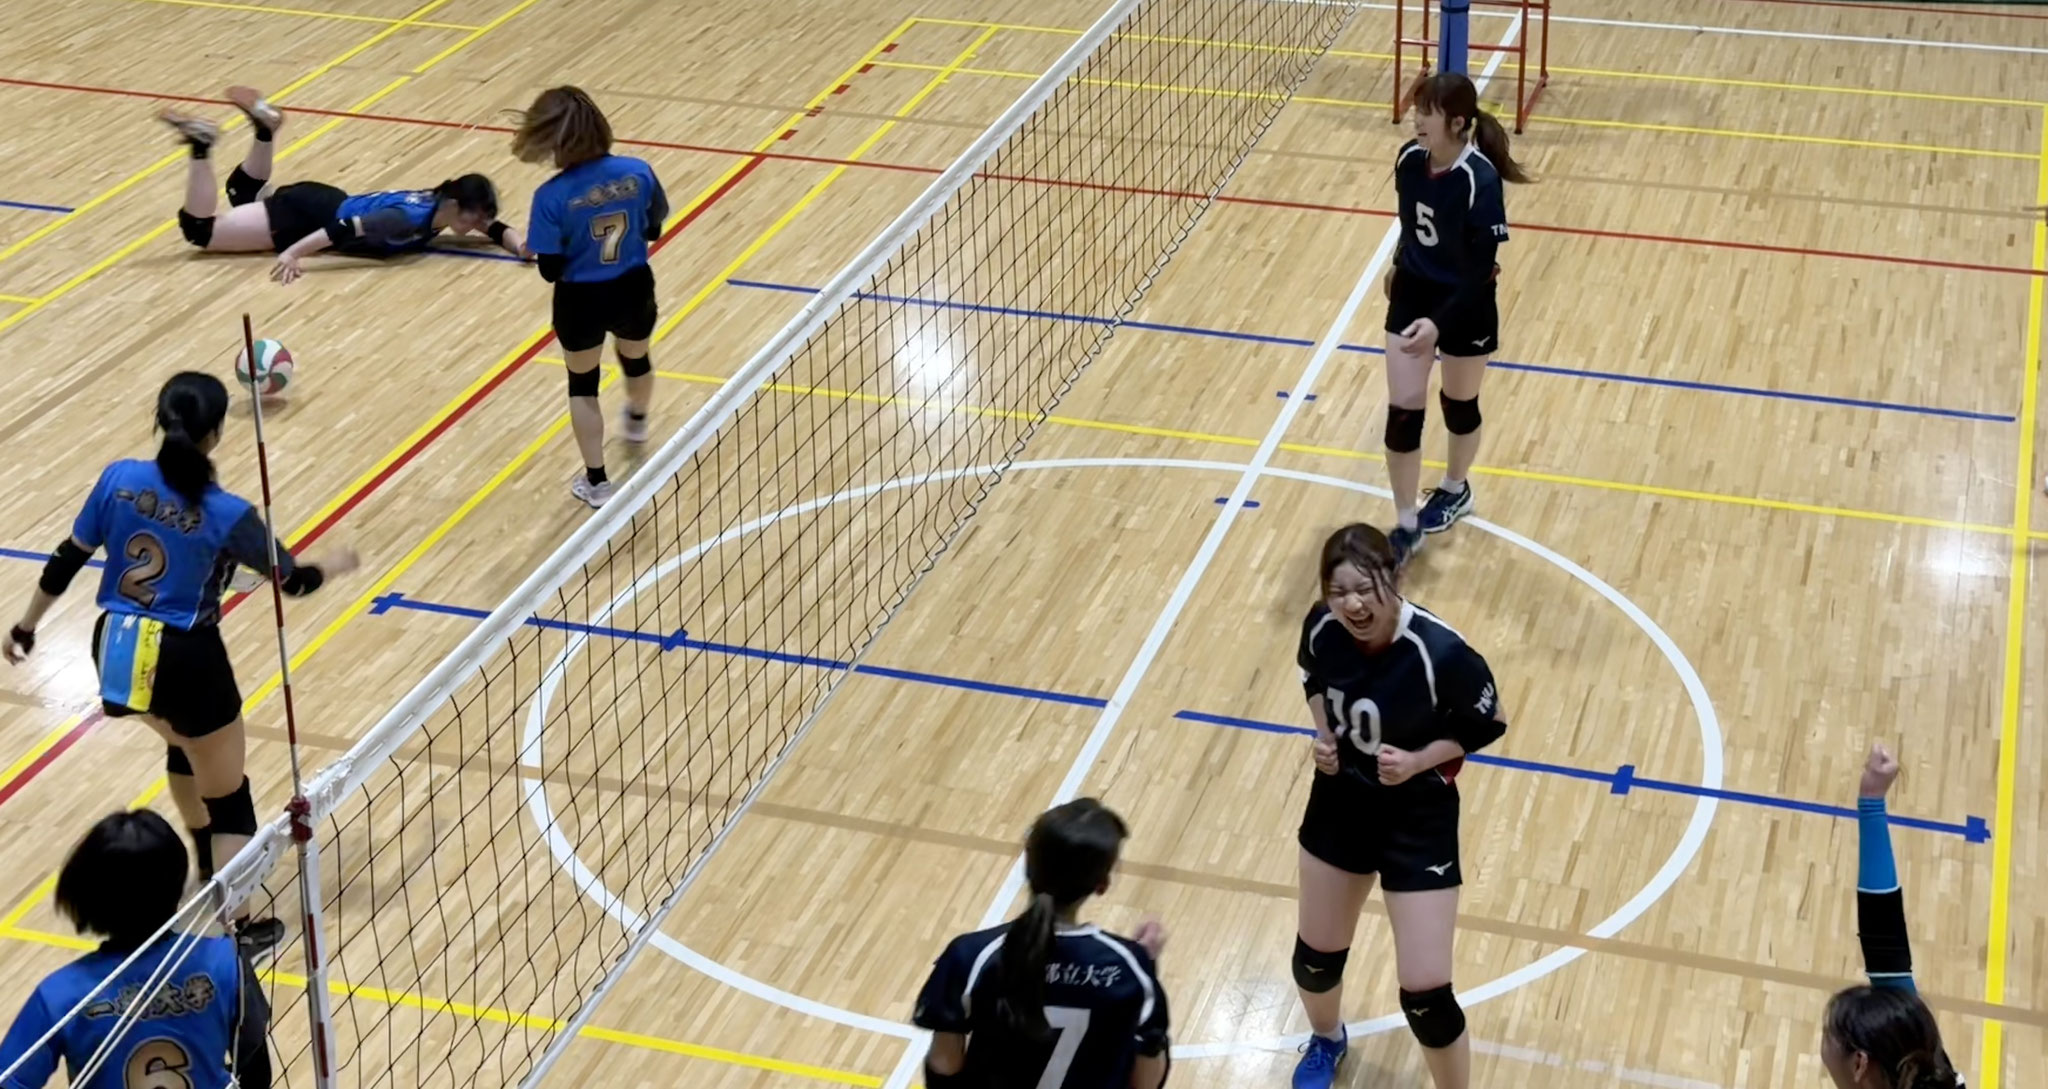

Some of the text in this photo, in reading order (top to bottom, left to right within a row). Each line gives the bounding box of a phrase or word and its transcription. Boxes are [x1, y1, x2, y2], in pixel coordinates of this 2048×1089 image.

[589, 209, 629, 264] 7
[1415, 201, 1440, 247] 5
[118, 529, 168, 609] 2
[1326, 686, 1382, 756] 10
[123, 1035, 195, 1089] 6
[1034, 1005, 1092, 1089] 7
